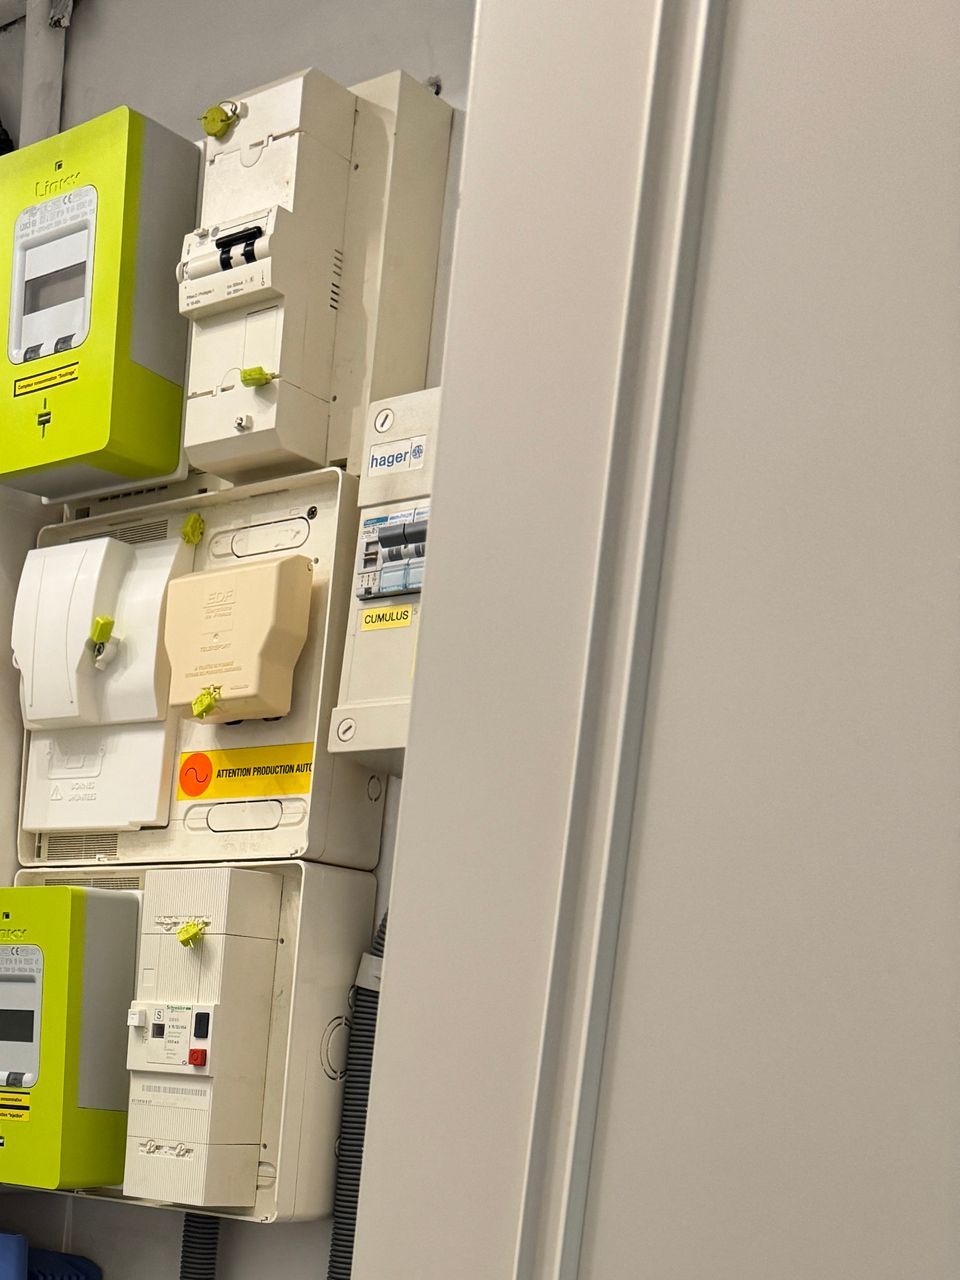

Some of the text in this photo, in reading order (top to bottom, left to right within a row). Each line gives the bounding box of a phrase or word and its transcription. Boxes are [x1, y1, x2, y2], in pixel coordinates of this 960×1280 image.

[370, 451, 409, 469] hager
[364, 610, 409, 624] CUMULUS
[216, 767, 251, 778] ATTENTION
[252, 764, 294, 776] PRODUCTION
